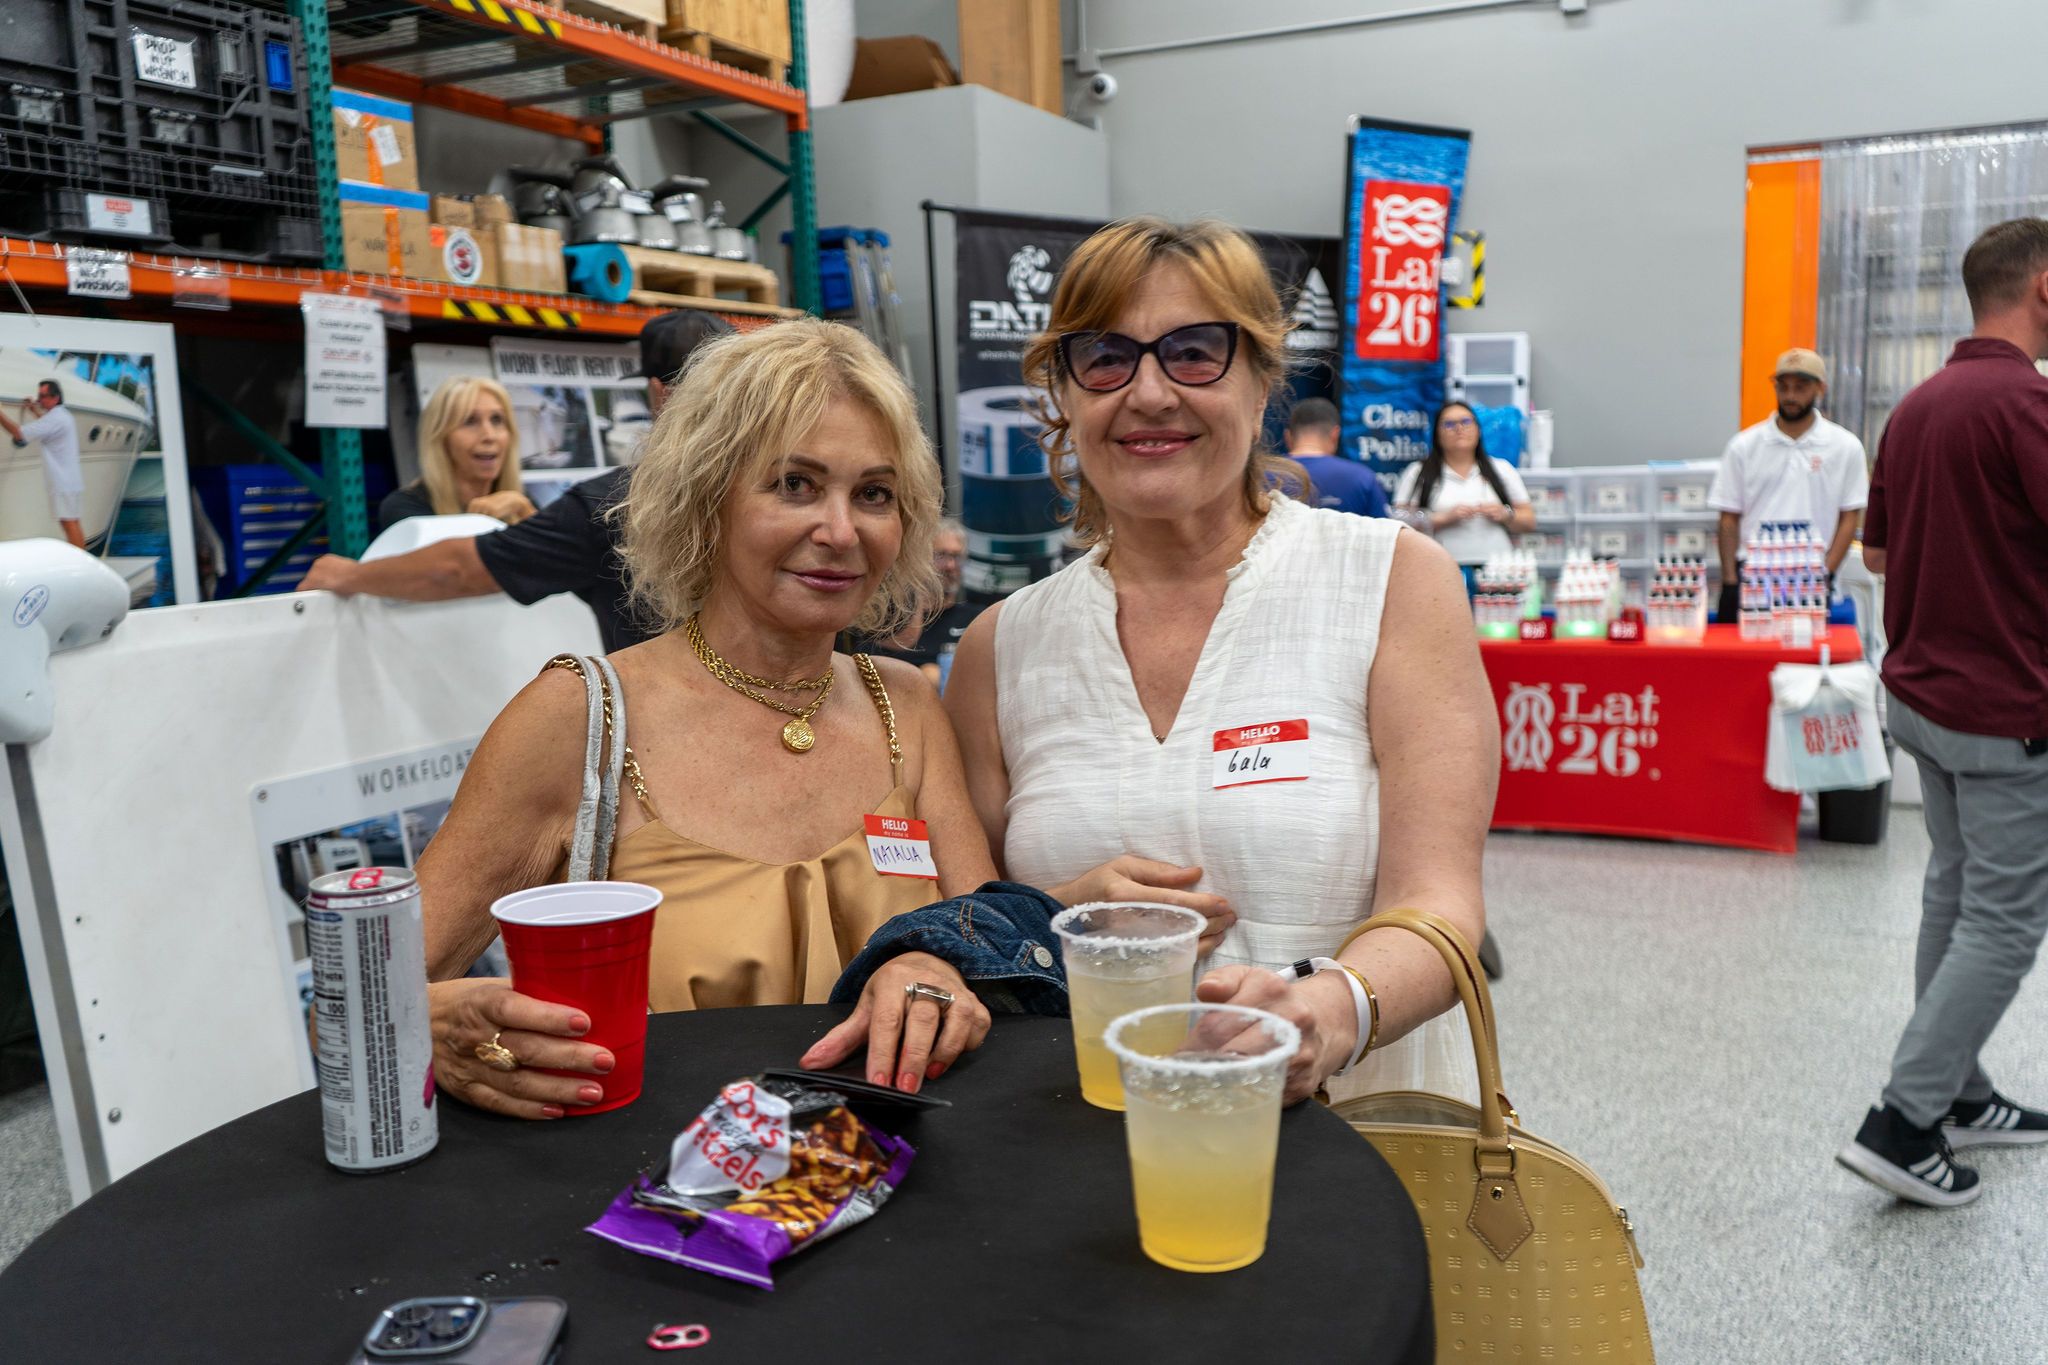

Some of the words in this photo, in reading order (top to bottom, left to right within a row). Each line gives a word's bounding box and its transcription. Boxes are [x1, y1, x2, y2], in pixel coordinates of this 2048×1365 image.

[500, 351, 536, 374] WORK
[1559, 683, 1661, 727] Lat
[1240, 725, 1280, 740] HELLO
[881, 818, 909, 832] HELLO
